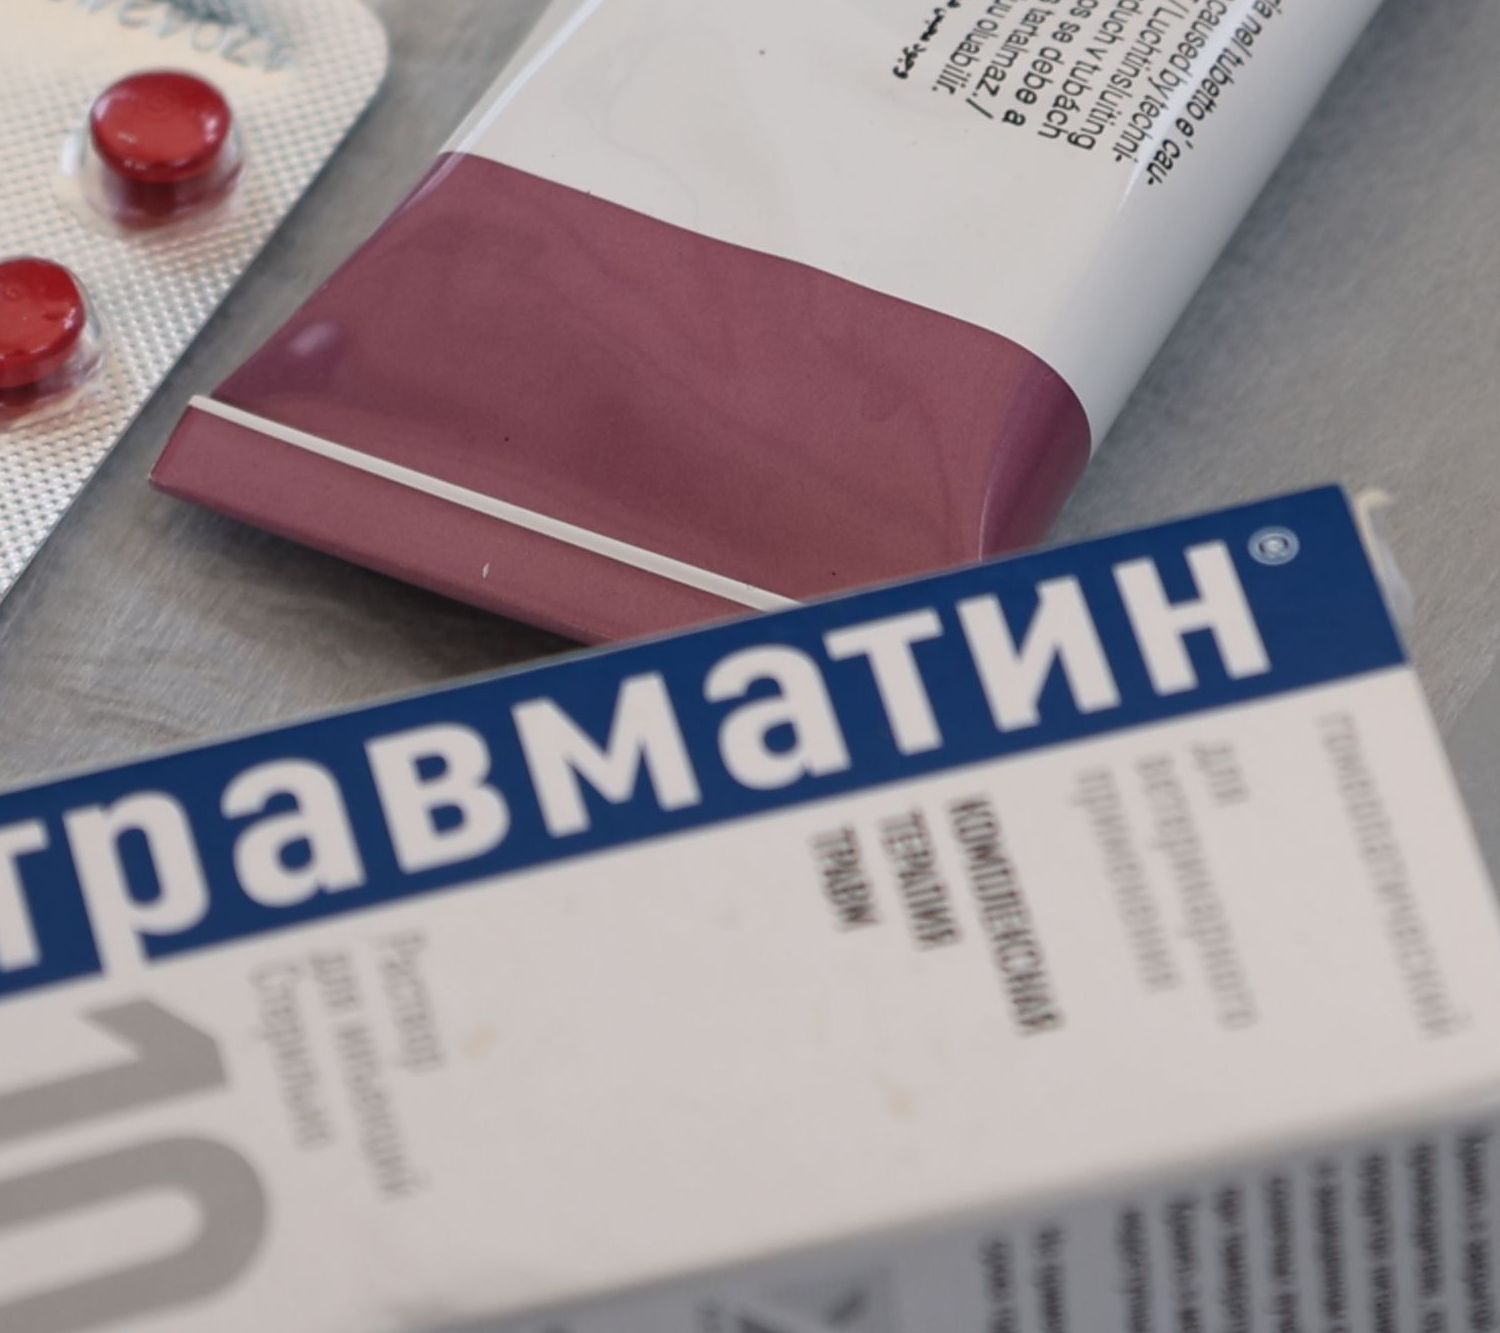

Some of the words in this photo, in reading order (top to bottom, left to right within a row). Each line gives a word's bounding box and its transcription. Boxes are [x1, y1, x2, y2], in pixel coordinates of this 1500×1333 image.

[1049, 17, 1082, 47] se
[1228, 14, 1268, 58] nel
[1011, 43, 1066, 108] debe
[1032, 56, 1106, 146] tubách
[1064, 2, 1185, 155] Luchtinsluiting
[1144, 64, 1186, 103] by
[1182, 46, 1248, 125] tubetto
[999, 106, 1028, 131] a
[1107, 91, 1170, 168] techni-
[1141, 137, 1184, 189] cau-
